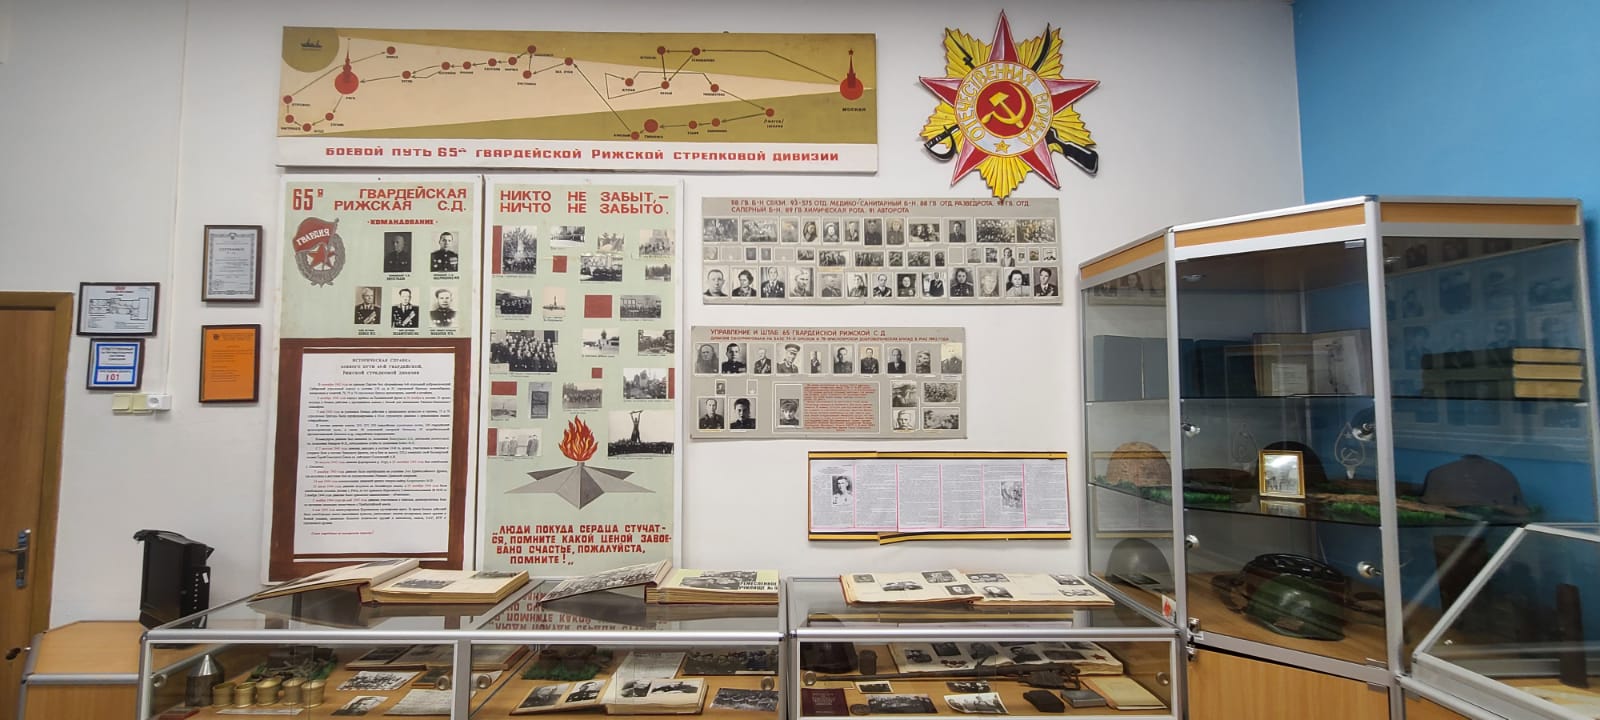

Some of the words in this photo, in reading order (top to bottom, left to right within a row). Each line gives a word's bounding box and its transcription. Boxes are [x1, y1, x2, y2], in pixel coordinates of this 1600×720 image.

[326, 146, 385, 157] БОЕВОЙ
[392, 147, 433, 157] ПУТЬ
[475, 148, 582, 160] ГВАРДЕЙСКОЙ
[673, 150, 766, 161] СТРЕЛКОВОЙ
[772, 152, 840, 162] ДИВИЗИИ
[359, 186, 468, 200] ГВАРДЕЙСКАЯ
[500, 190, 552, 202] НИКТО
[567, 191, 587, 202] НЕ
[334, 200, 413, 211] РИЖСКАЯ
[500, 202, 552, 213] НИЧТО
[567, 203, 587, 214] НЕ
[535, 525, 574, 534] ПОКУДА
[579, 524, 619, 533] СЕРДЦА
[510, 534, 556, 544] ПОМНИТЕ
[562, 533, 595, 544] КАКОЙ
[601, 533, 633, 544] ЦЕНОЙ
[496, 545, 523, 555] ВАНО
